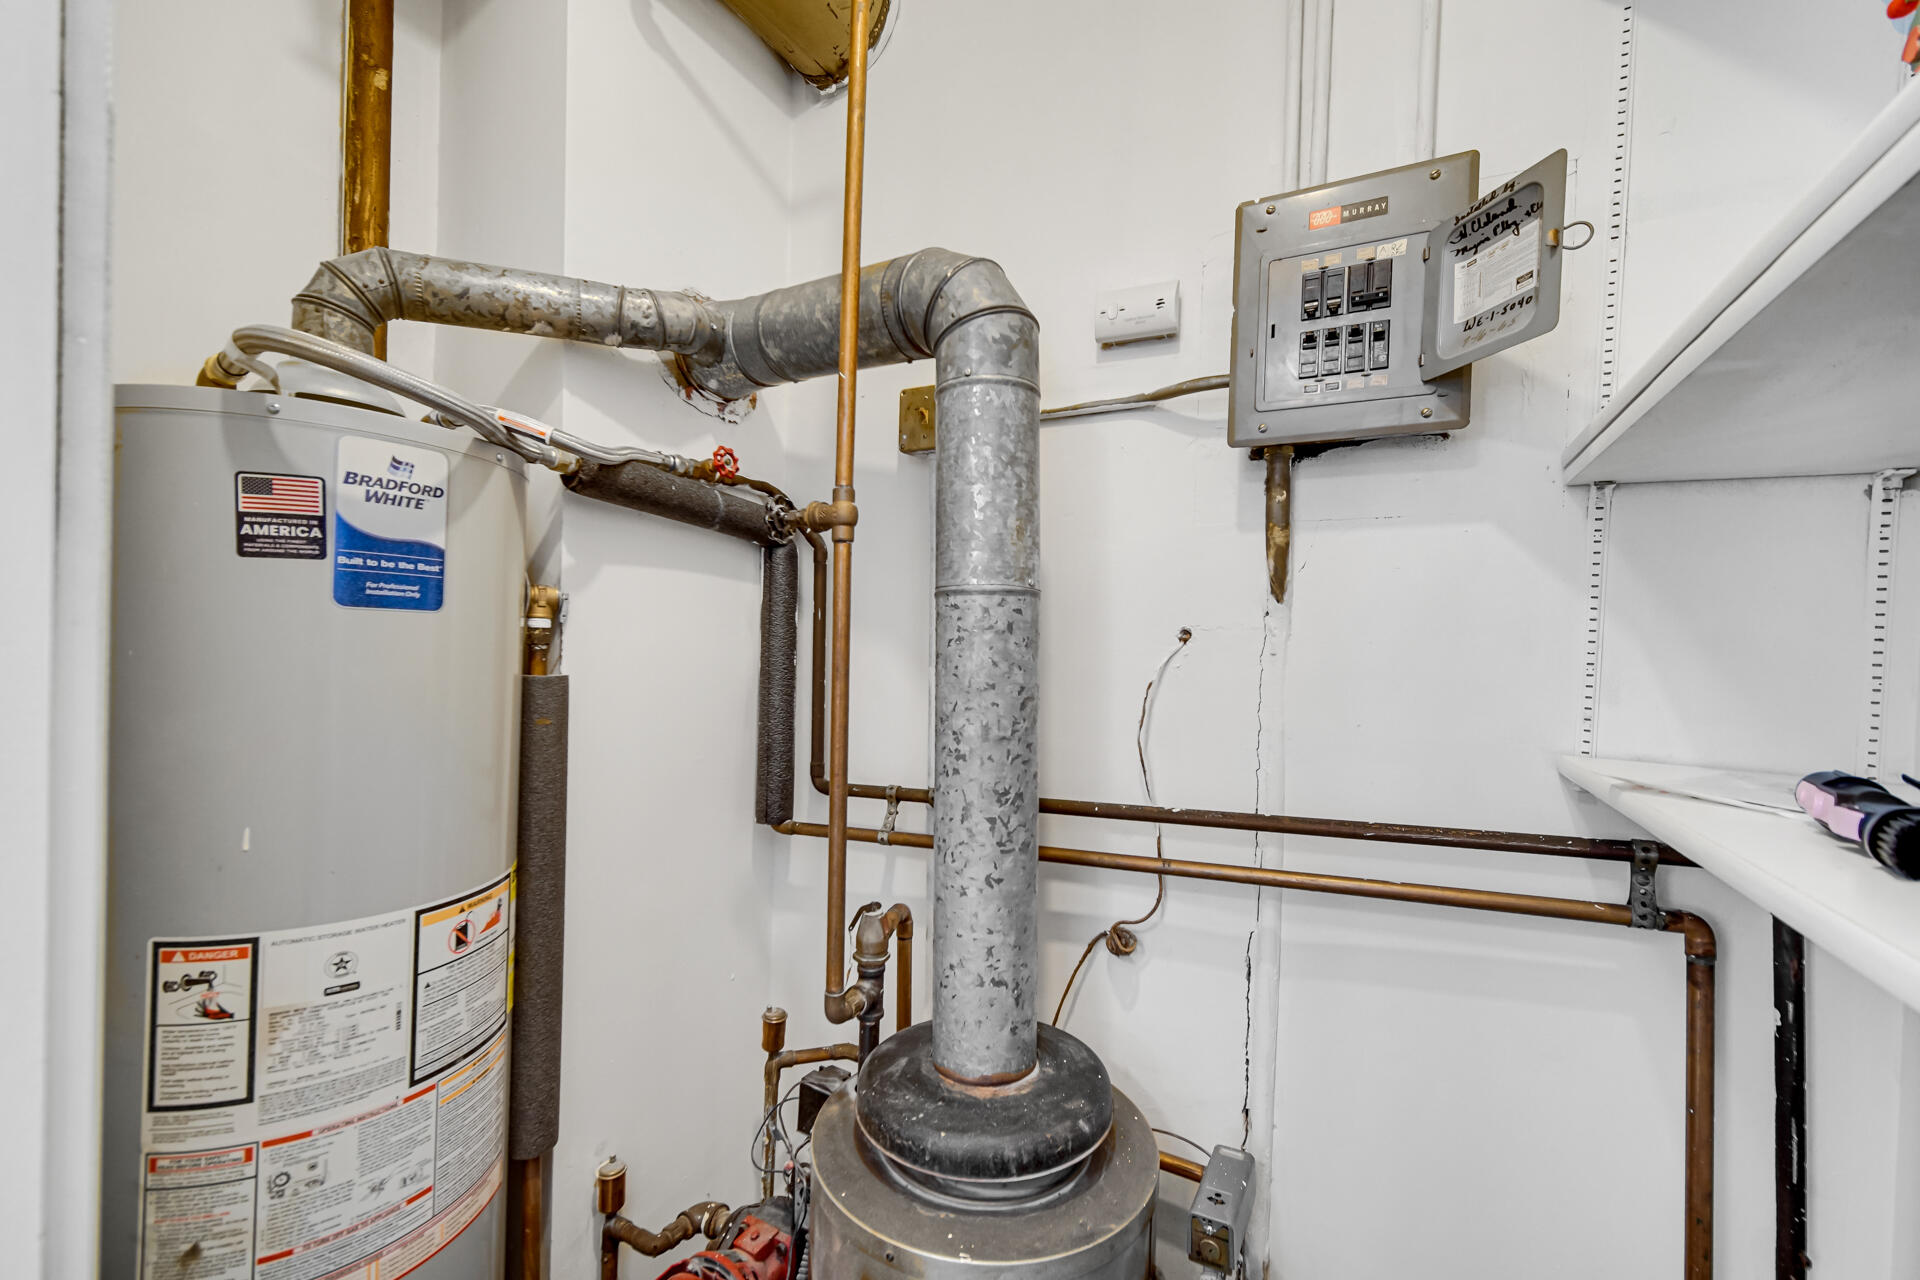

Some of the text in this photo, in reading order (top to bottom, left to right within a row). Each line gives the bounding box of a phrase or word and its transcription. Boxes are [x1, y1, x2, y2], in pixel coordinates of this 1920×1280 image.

[1343, 202, 1387, 217] MURRAY
[343, 470, 445, 499] BRADFORD
[365, 488, 426, 511] WHITE
[243, 516, 308, 525] MANUFACTURED
[240, 523, 323, 538] AMERICA
[337, 555, 364, 566] Built
[366, 558, 378, 567] to
[380, 559, 396, 568] be
[398, 561, 415, 570] the
[188, 949, 240, 961] DANGER
